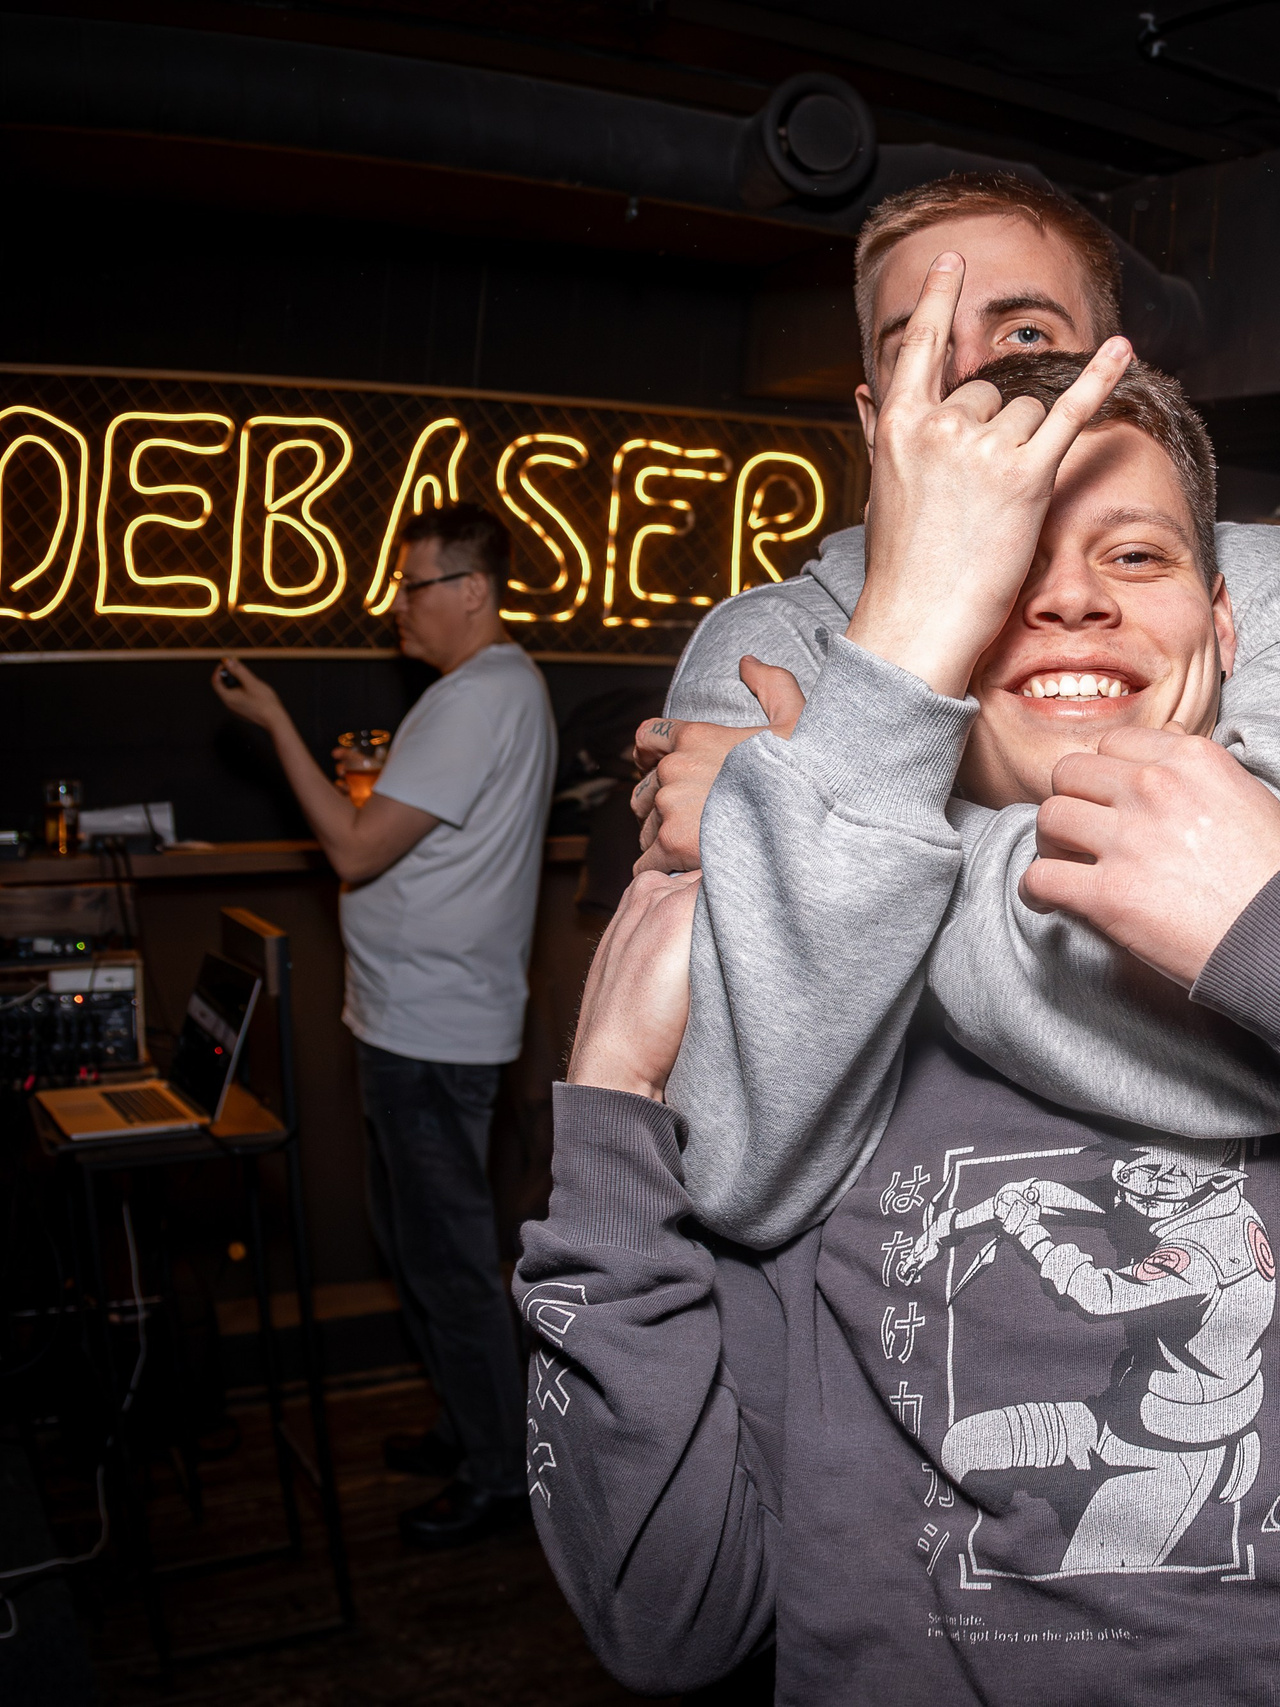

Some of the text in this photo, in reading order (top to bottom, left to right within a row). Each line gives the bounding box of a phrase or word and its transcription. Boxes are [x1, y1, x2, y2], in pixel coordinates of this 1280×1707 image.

[959, 1613, 985, 1626] late.
[969, 1630, 990, 1645] got
[994, 1629, 1019, 1643] lost
[1023, 1633, 1038, 1643] on
[1042, 1629, 1062, 1641] the
[1065, 1628, 1093, 1642] path
[1097, 1628, 1109, 1641] of
